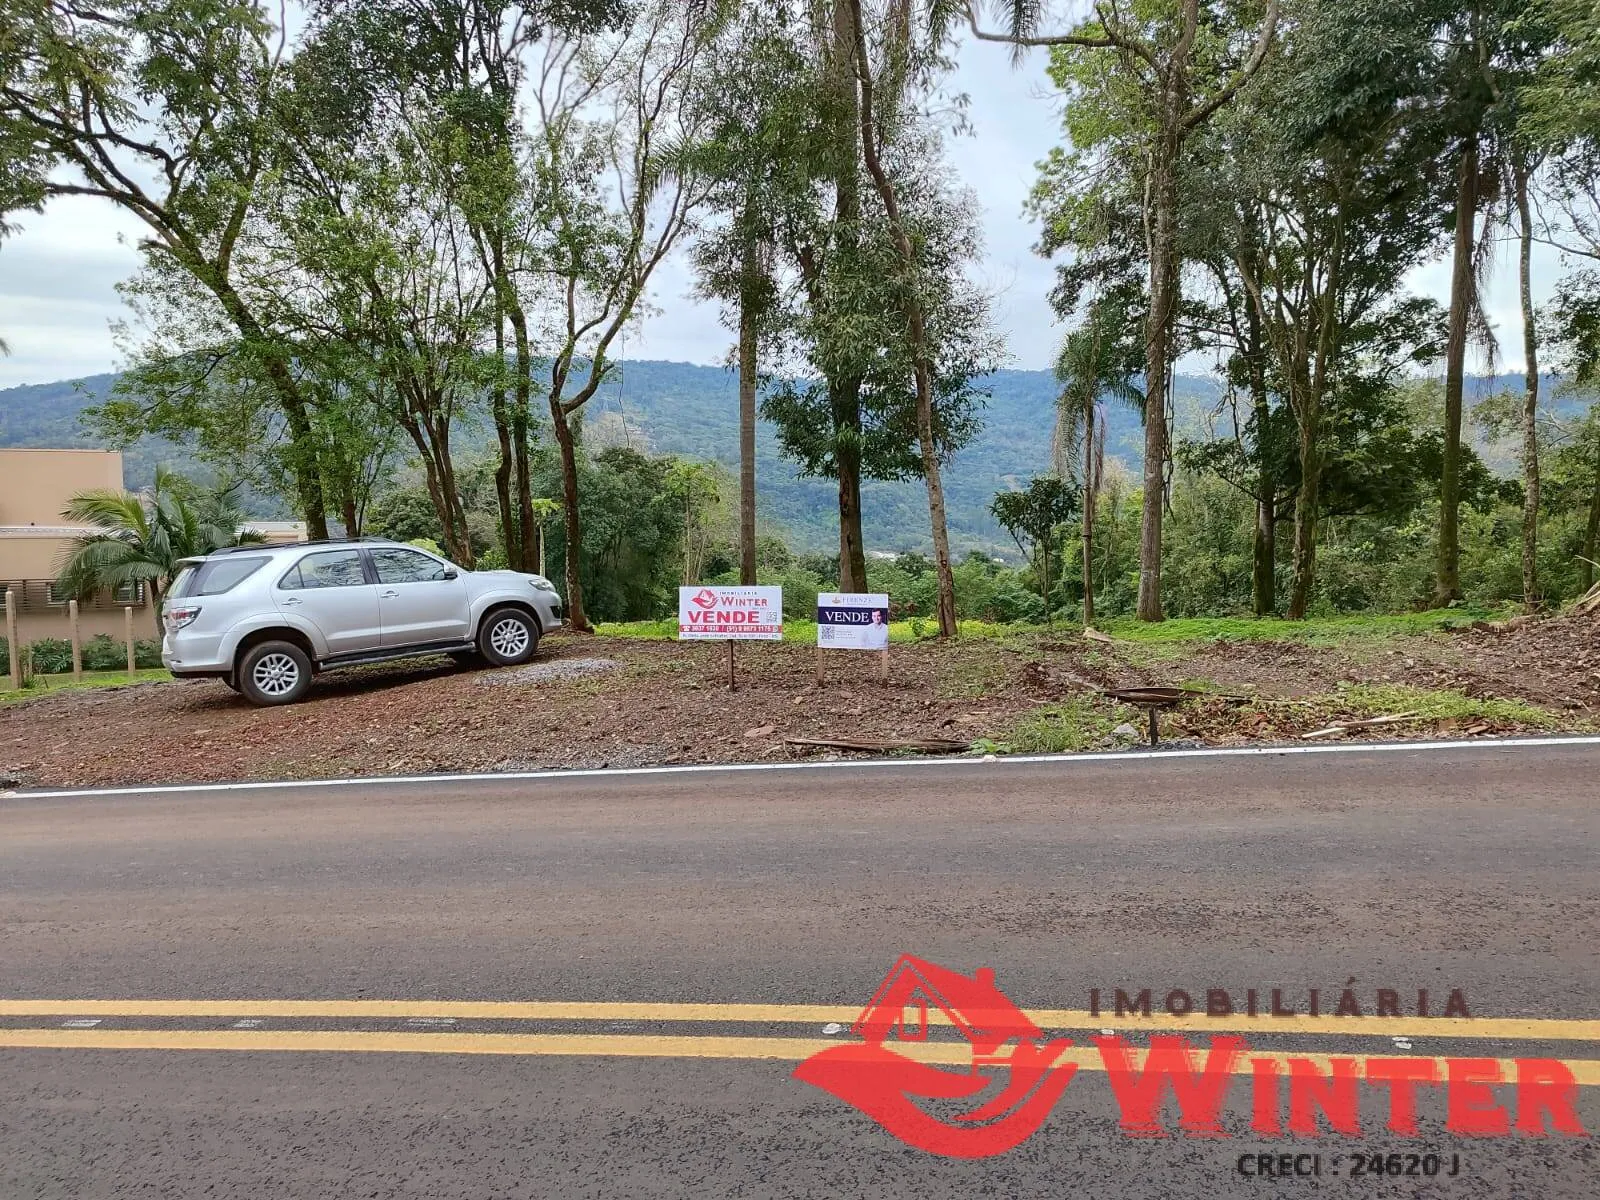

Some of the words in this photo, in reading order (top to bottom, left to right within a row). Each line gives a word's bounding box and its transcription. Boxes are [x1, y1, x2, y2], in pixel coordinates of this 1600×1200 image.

[720, 596, 768, 606] WINTER
[687, 610, 760, 624] VENDE
[825, 611, 870, 623] VENDE
